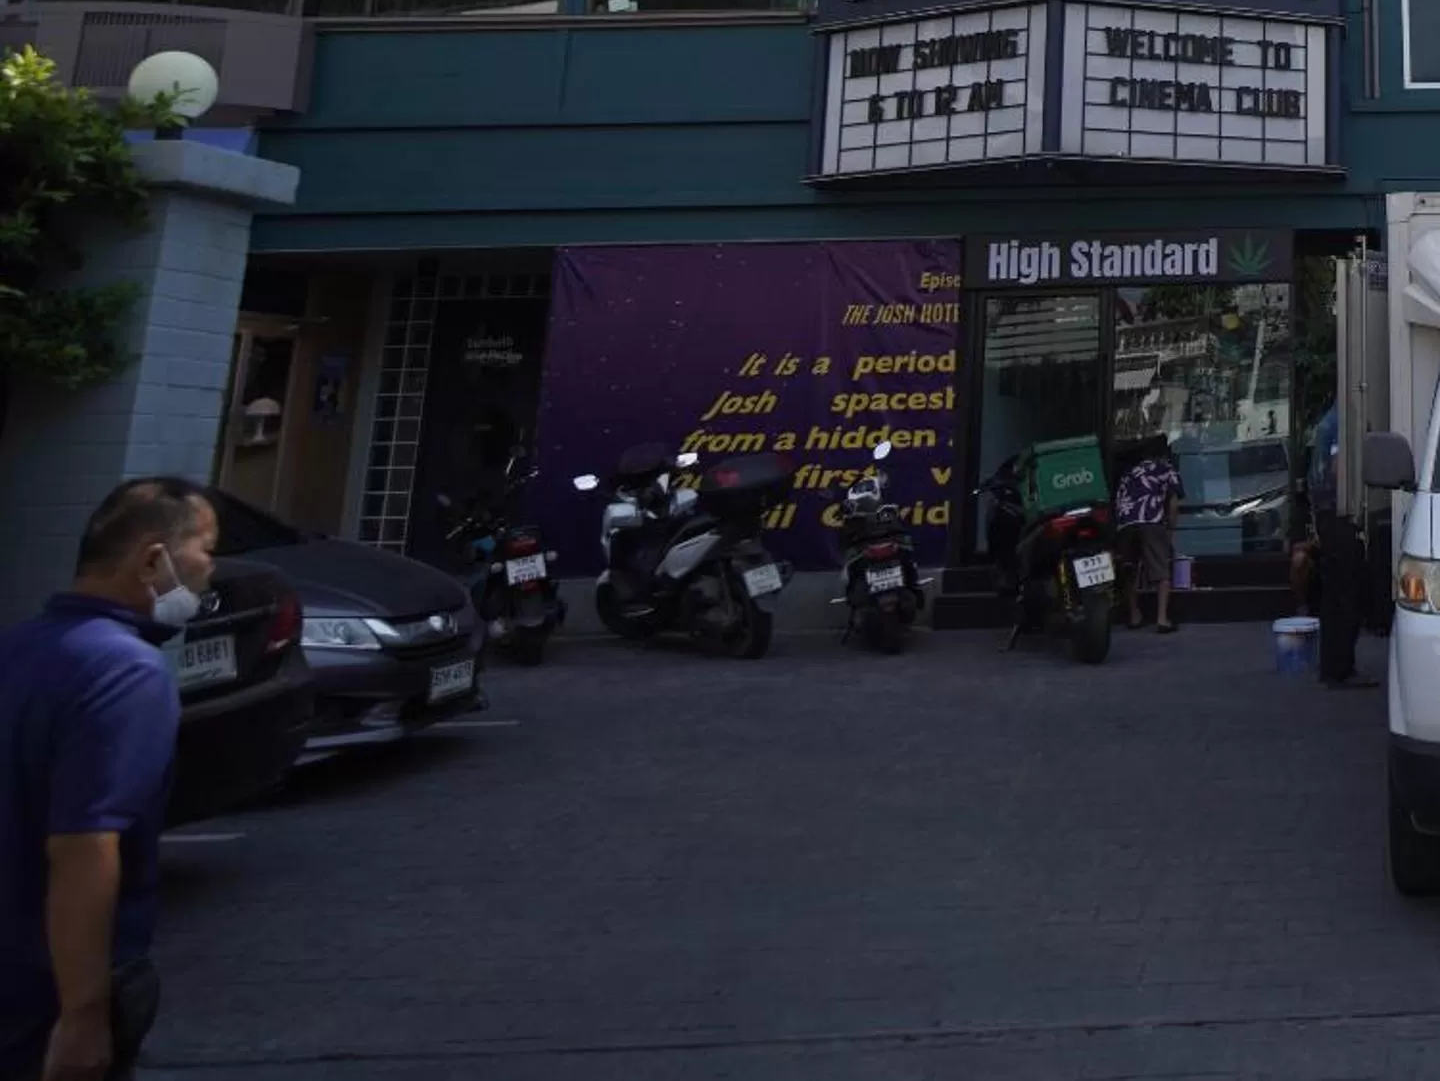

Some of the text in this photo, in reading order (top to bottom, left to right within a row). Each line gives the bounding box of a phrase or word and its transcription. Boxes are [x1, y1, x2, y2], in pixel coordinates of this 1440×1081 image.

[850, 45, 901, 78] NOW
[1105, 27, 1291, 69] WELCOME TO
[894, 90, 924, 119] TO
[968, 78, 1004, 112] AM
[1110, 76, 1301, 118] CINEMA CLUB
[988, 237, 1218, 285] High Standard
[842, 303, 874, 327] THE
[872, 302, 917, 325] JOSH
[738, 348, 958, 382] It is a period
[699, 388, 778, 421] Josh
[679, 424, 937, 453] from a hidden
[1052, 467, 1094, 489] Grab
